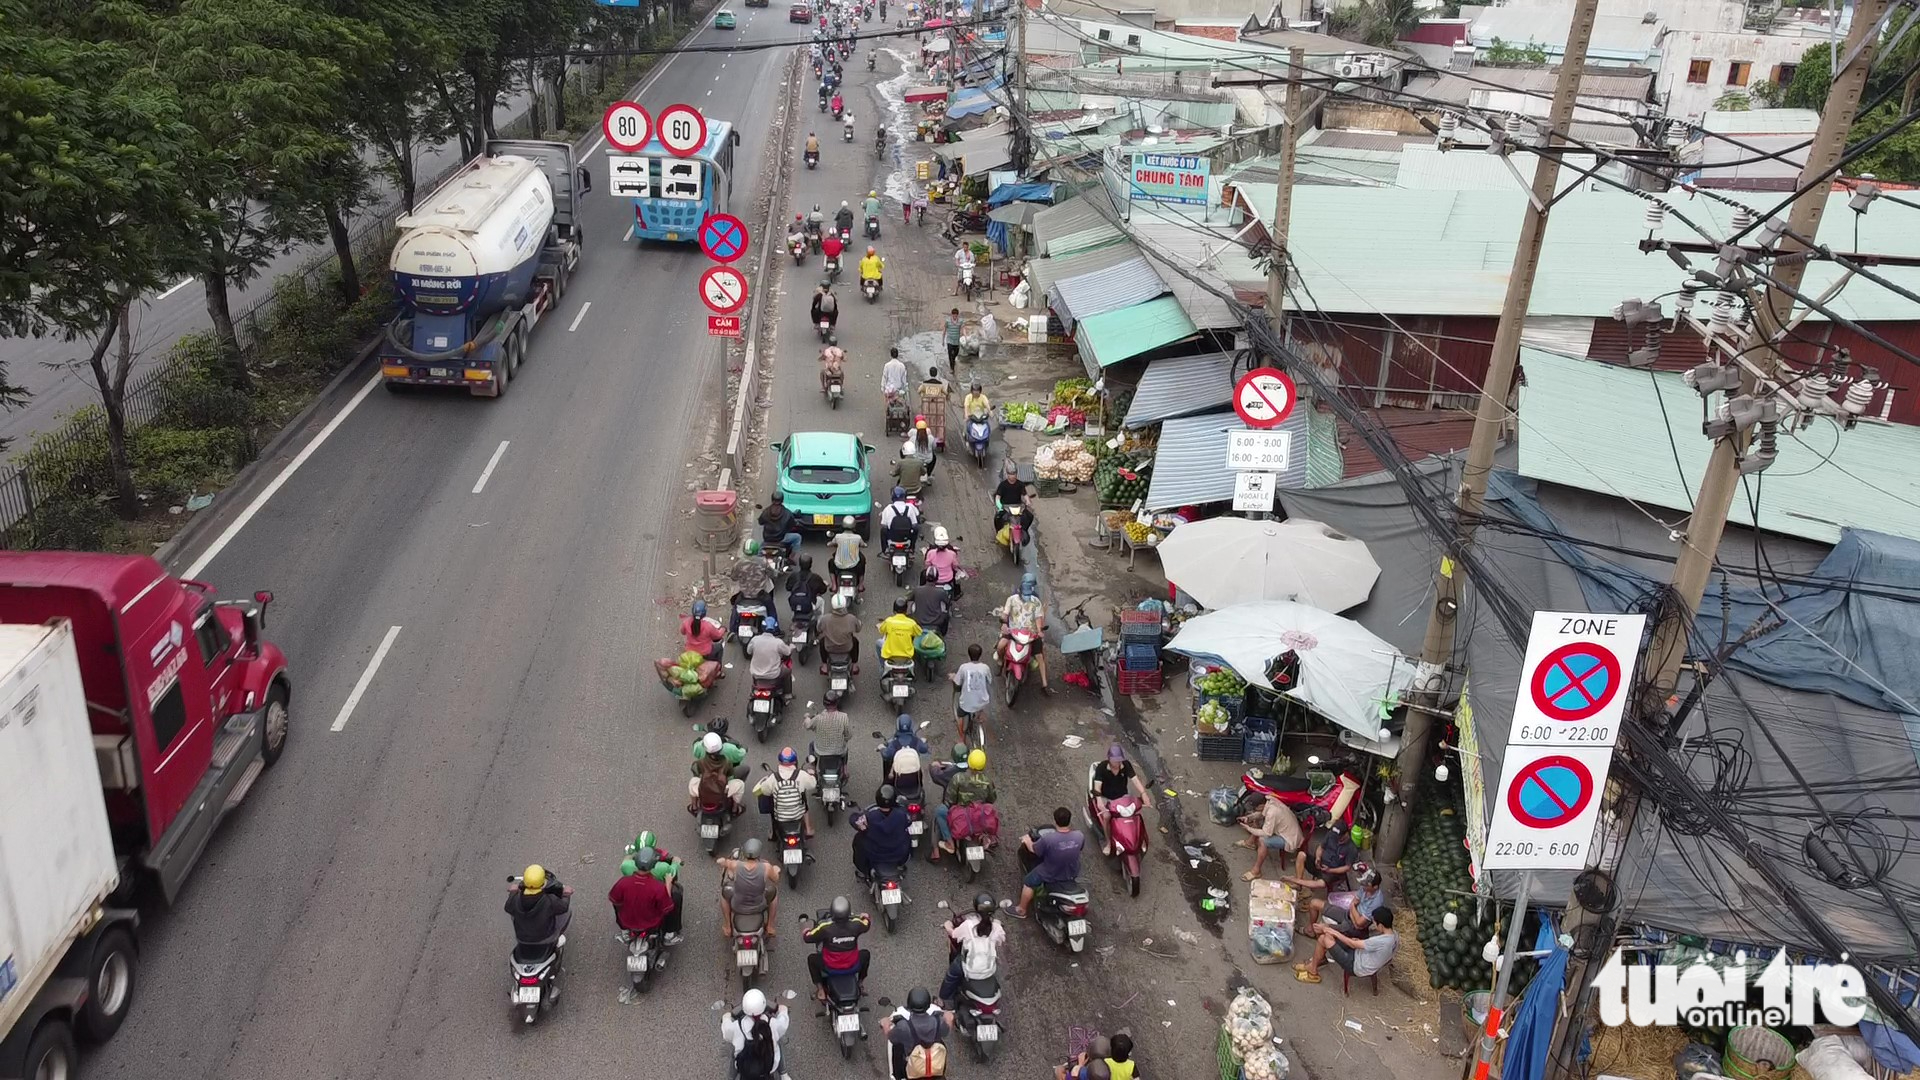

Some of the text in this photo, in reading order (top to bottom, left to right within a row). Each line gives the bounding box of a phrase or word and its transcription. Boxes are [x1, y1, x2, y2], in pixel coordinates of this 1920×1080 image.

[618, 116, 636, 136] 80
[673, 120, 690, 140] 60
[1136, 170, 1204, 188] CHUNG TÂM
[1559, 618, 1618, 636] ZONE
[1520, 726, 1552, 740] 6:00
[1568, 727, 1608, 740] 22:00
[1495, 842, 1534, 856] 22:00
[1549, 842, 1580, 856] 6:00
